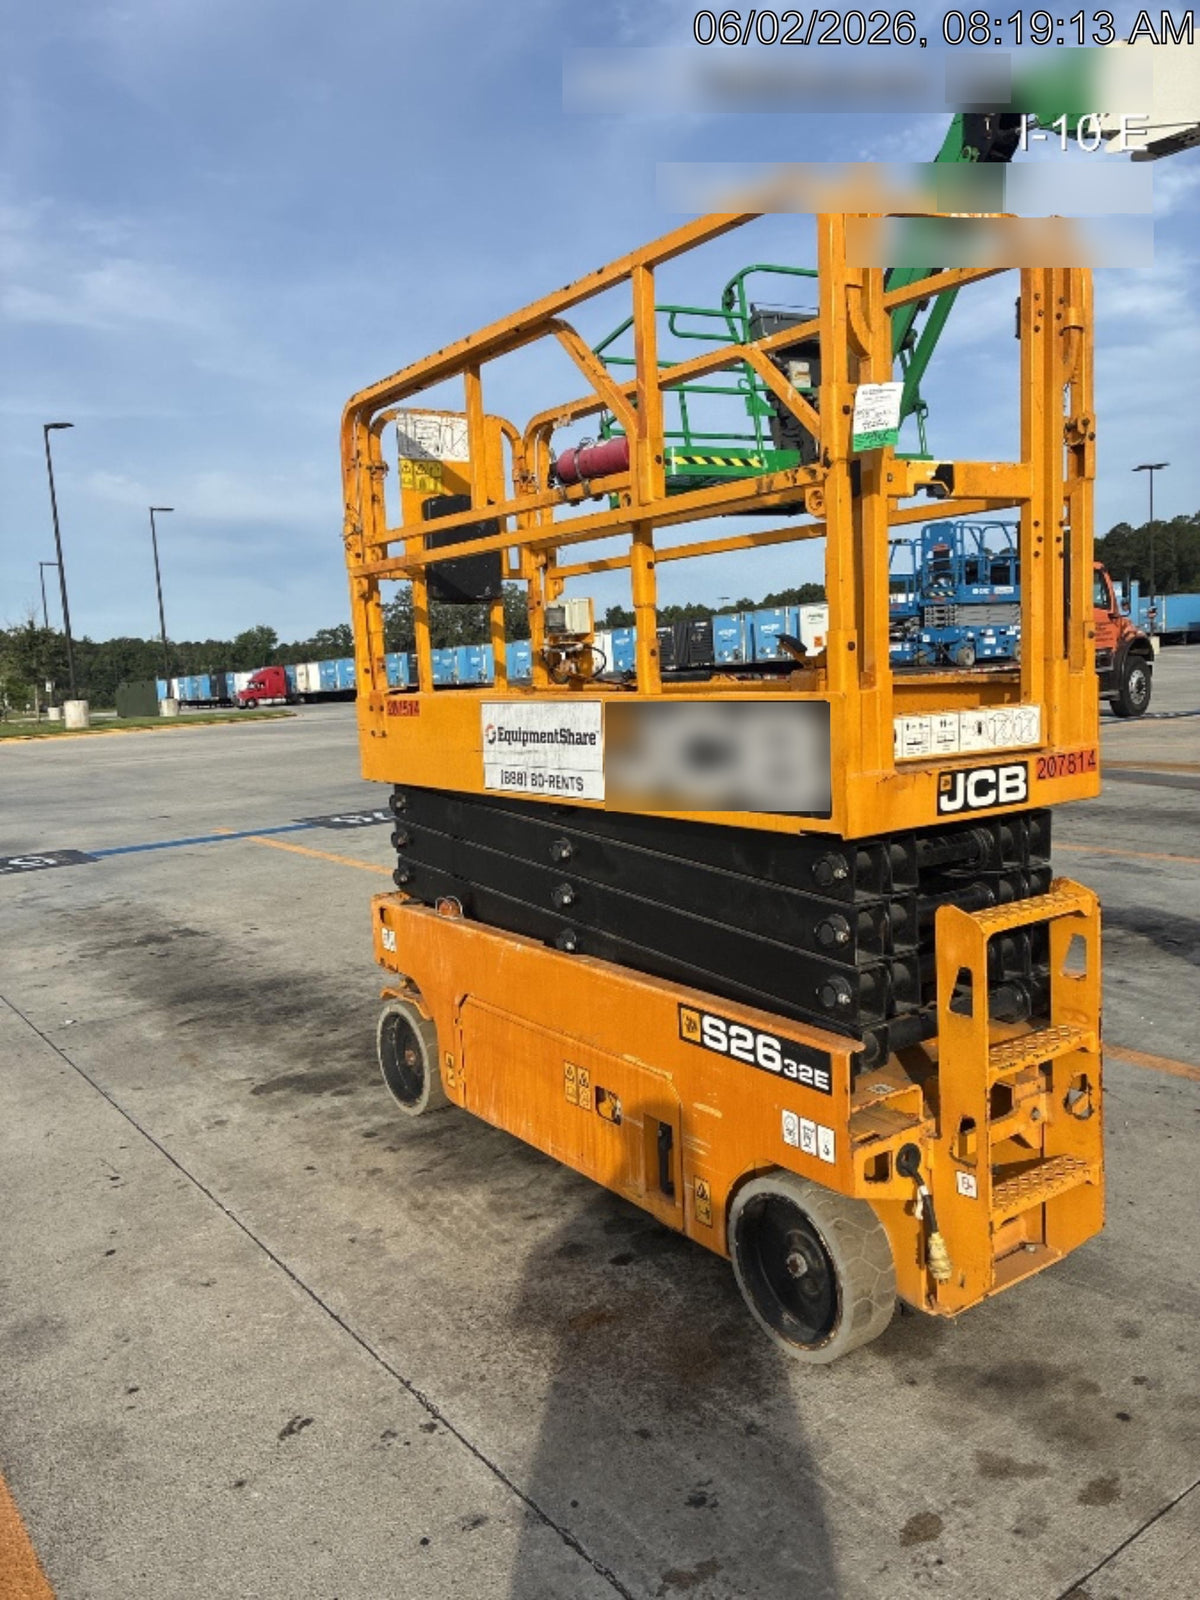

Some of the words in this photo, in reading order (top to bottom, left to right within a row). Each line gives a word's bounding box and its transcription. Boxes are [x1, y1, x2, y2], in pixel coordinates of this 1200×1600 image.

[497, 726, 598, 747] EquipmentShare
[940, 765, 1027, 811] JCB
[702, 1015, 782, 1073] S26
[783, 1058, 830, 1091] 32E
